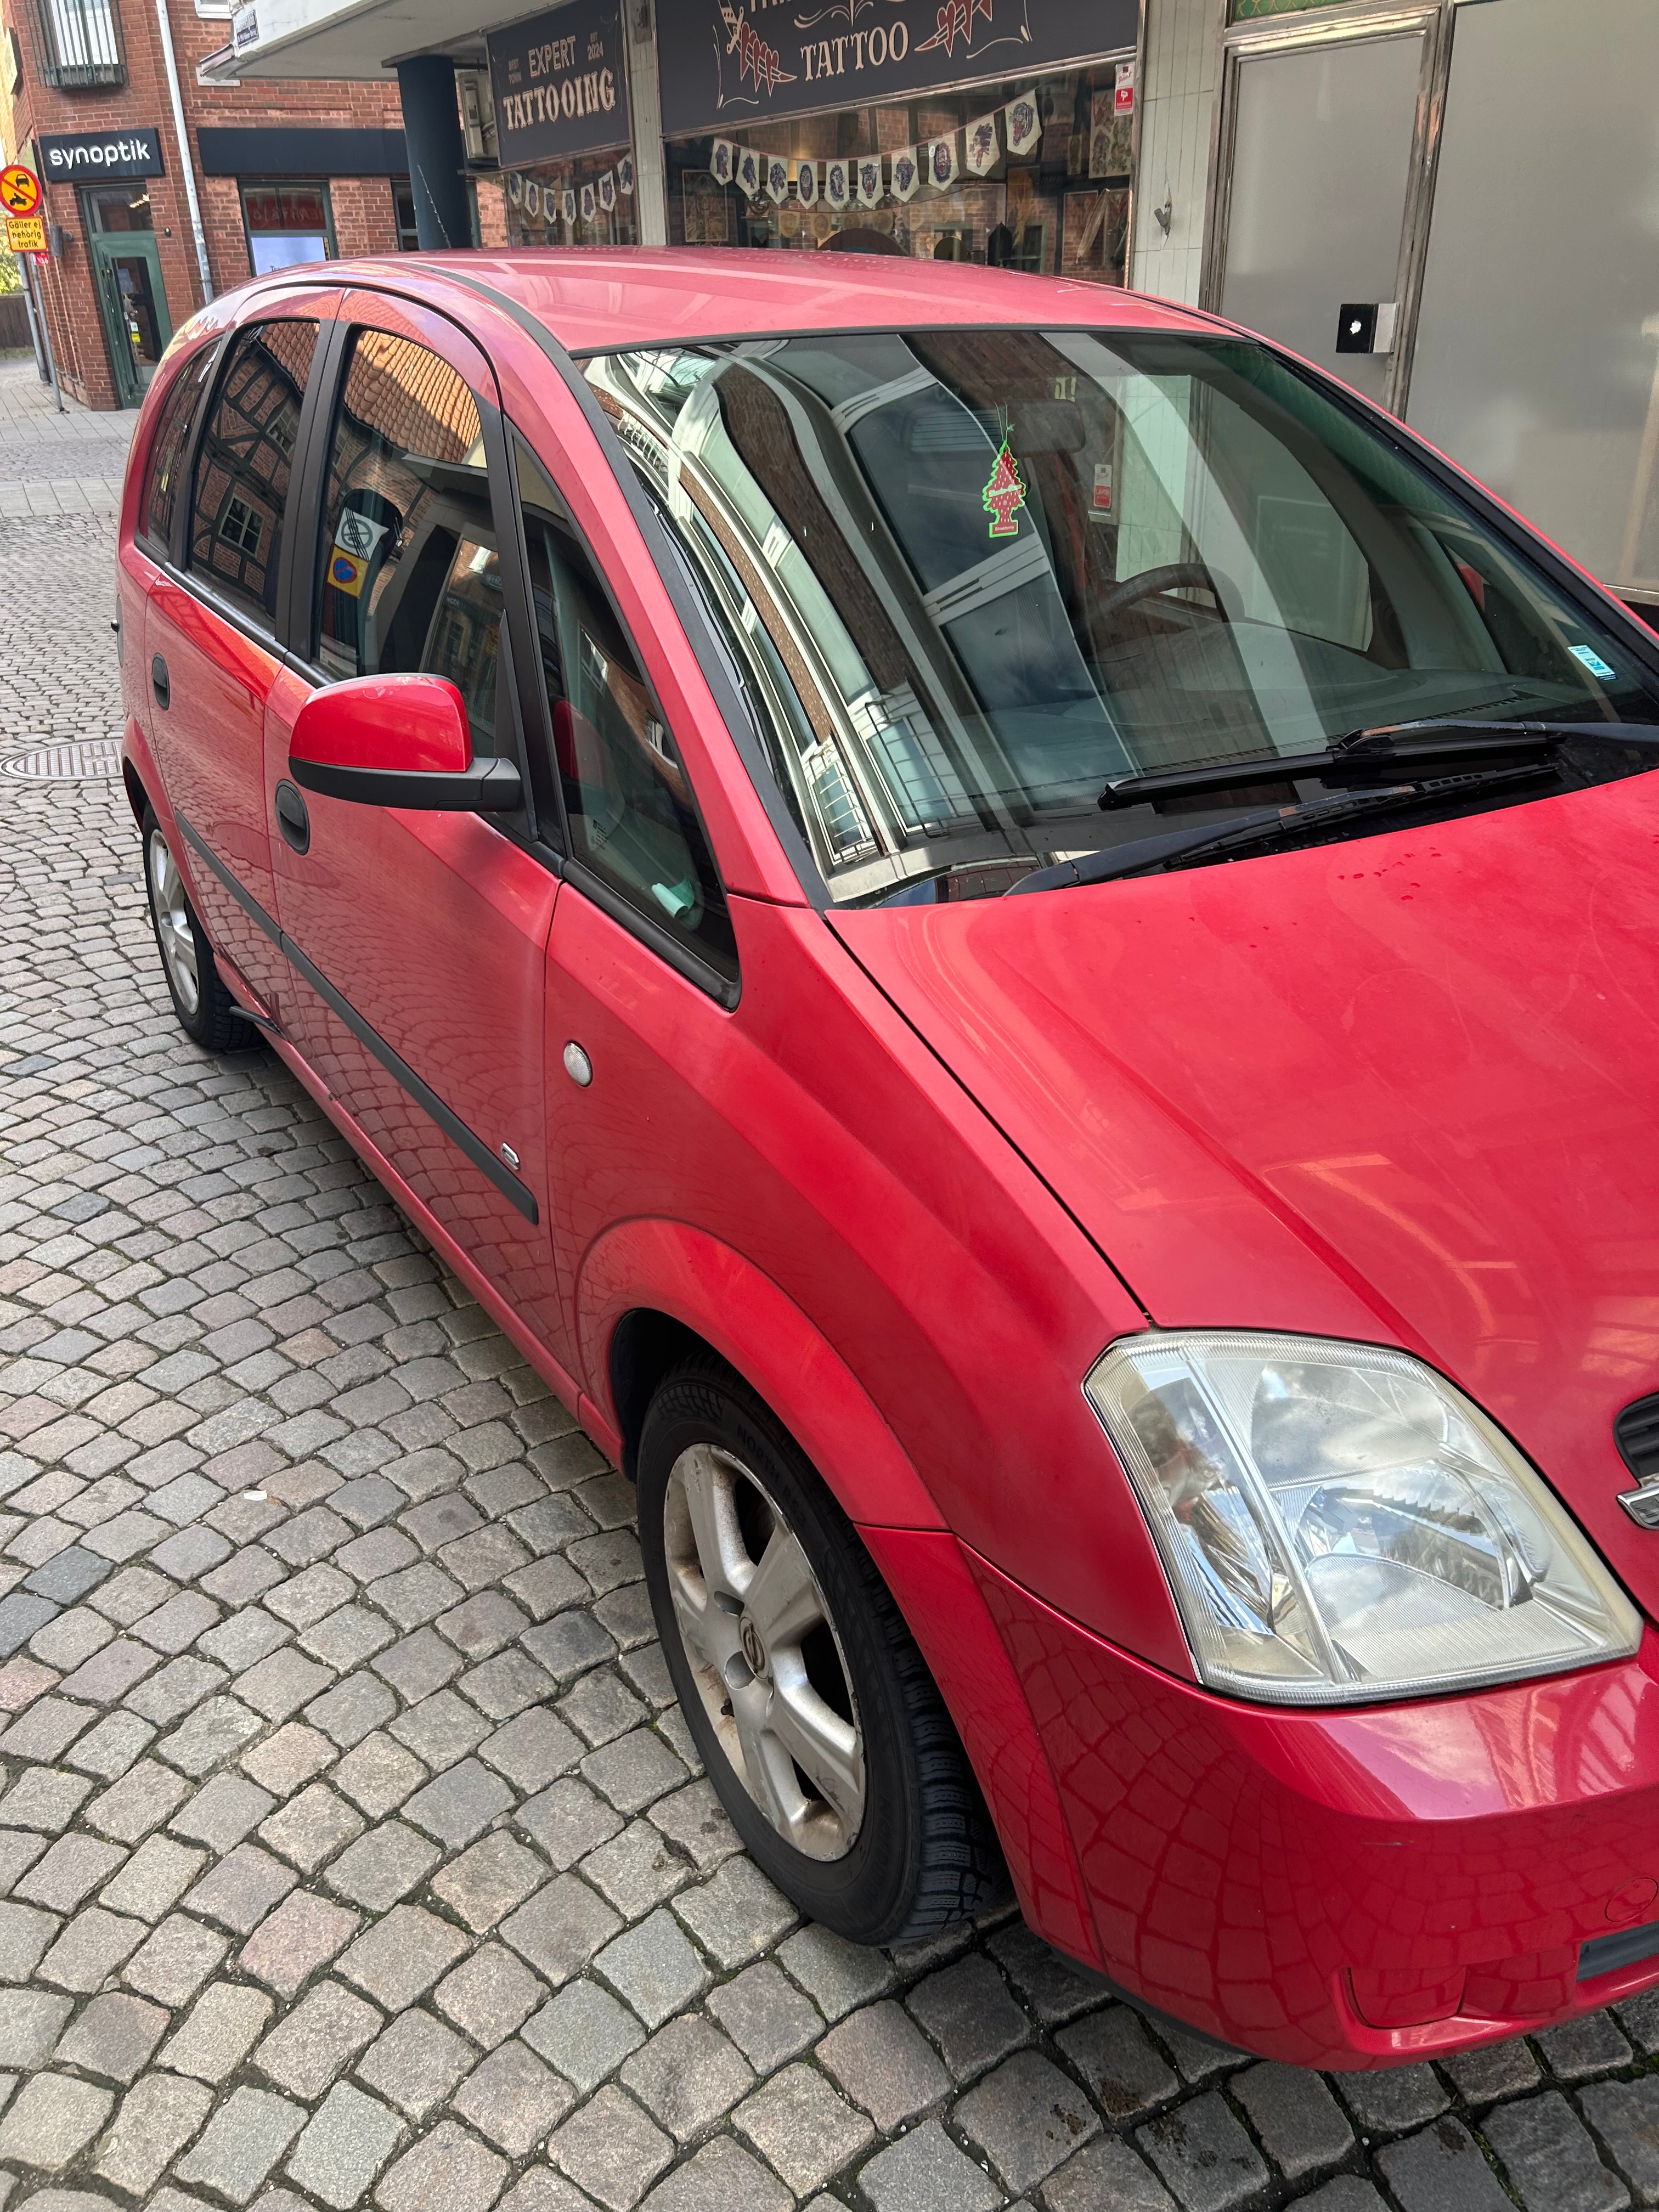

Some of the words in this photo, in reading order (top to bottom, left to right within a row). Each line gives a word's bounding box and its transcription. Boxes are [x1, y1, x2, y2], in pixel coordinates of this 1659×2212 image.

[528, 35, 575, 78] EXPERT
[588, 41, 603, 61] 2024
[800, 21, 909, 81] TATTOO
[503, 67, 616, 131] TATTOOING
[49, 138, 151, 170] synoptik
[9, 221, 31, 229] Gäller
[18, 240, 38, 249] trafik
